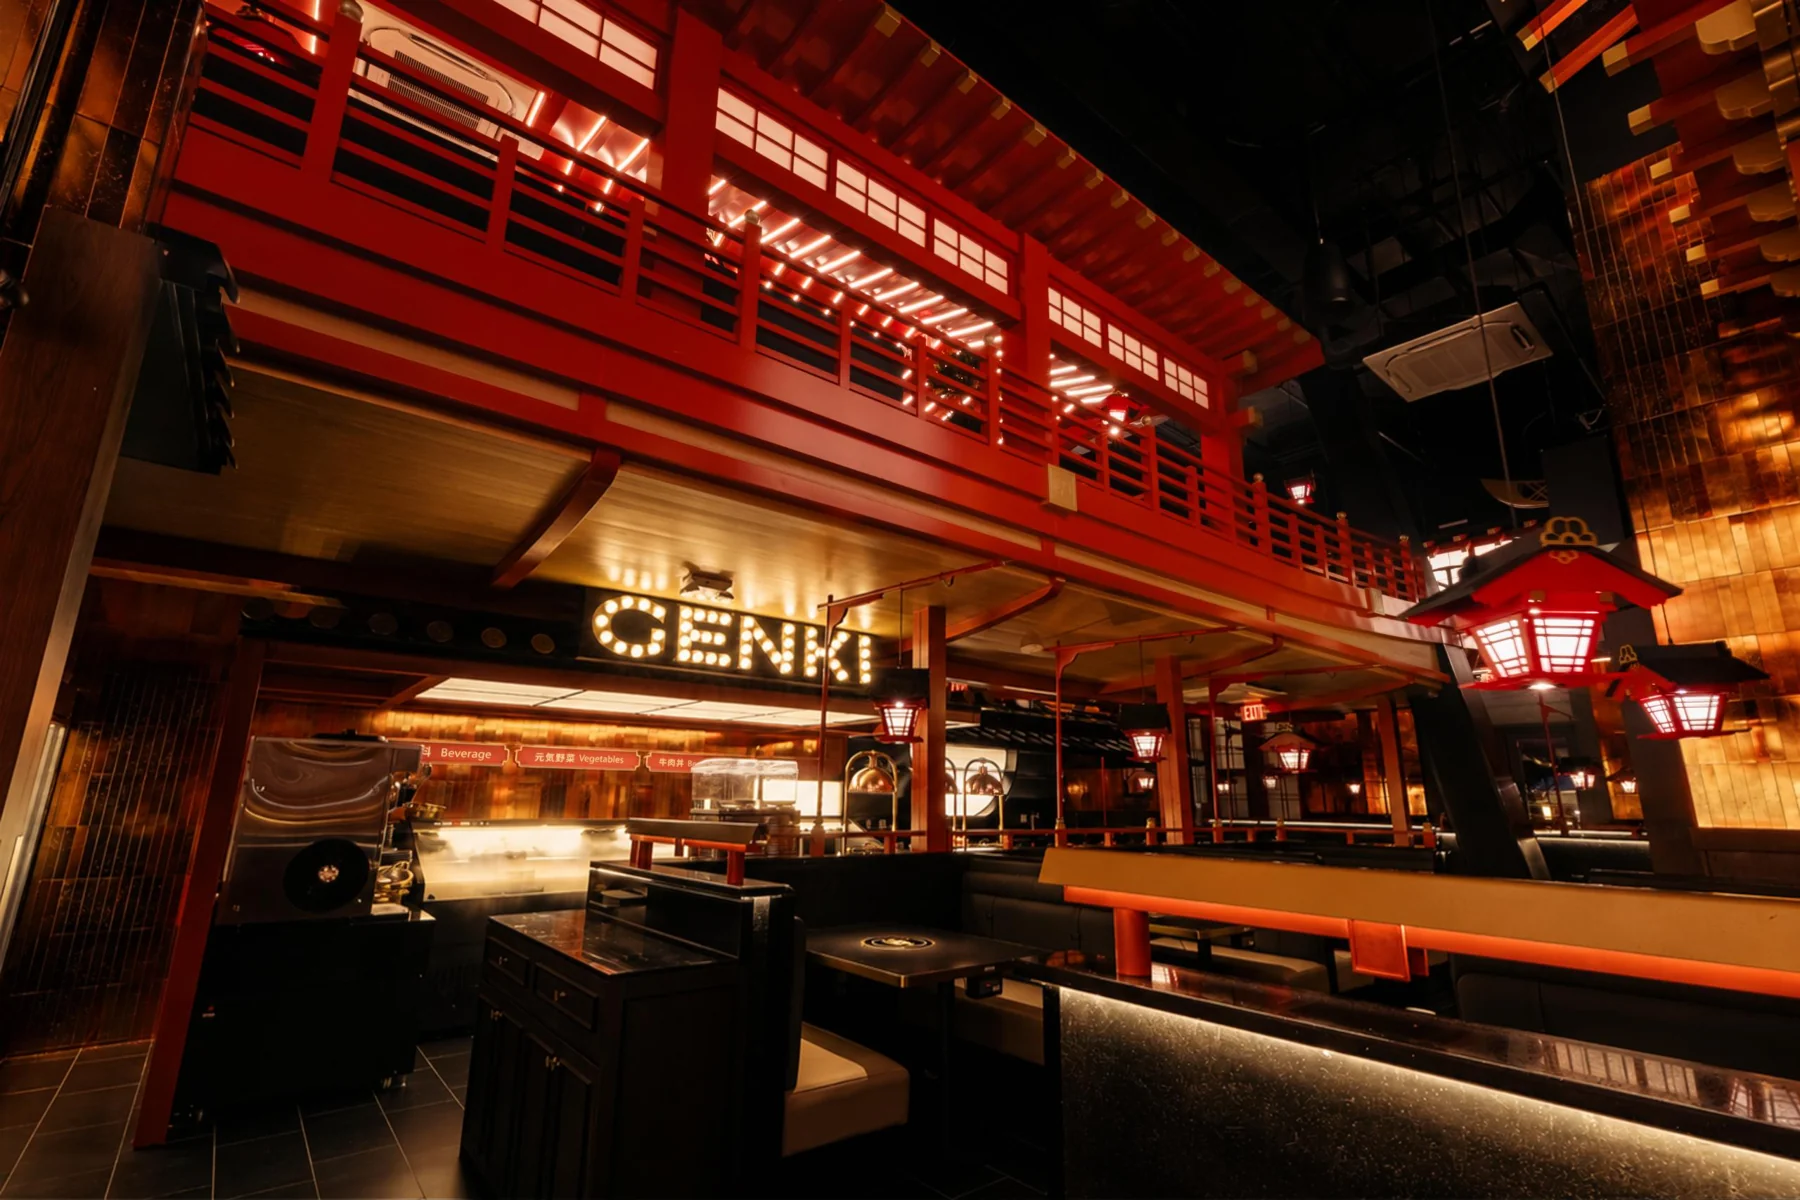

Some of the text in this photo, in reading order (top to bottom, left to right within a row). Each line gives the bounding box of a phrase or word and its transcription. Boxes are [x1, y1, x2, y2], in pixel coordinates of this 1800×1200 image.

[591, 595, 872, 684] GENKI
[1244, 704, 1266, 721] EXIT
[441, 748, 492, 761] Beverage
[579, 754, 624, 764] Vegetables
